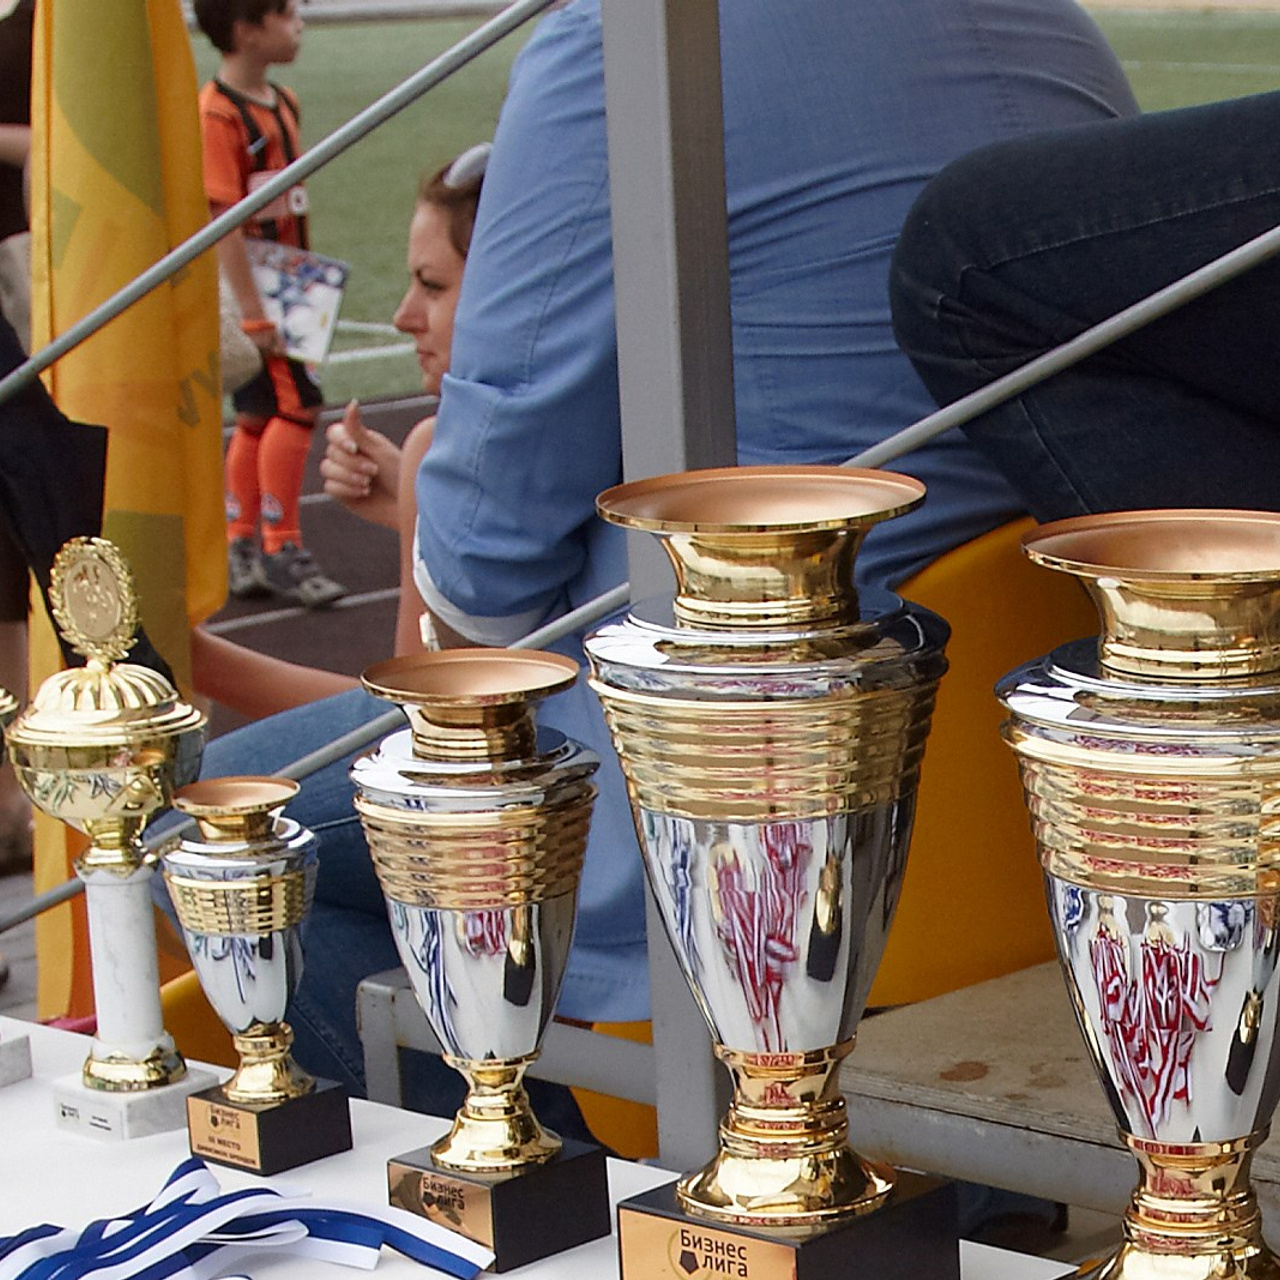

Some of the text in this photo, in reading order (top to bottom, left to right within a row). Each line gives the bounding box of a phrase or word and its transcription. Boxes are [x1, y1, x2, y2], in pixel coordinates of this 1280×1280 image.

[423, 1177, 464, 1199] Бизнес
[680, 1229, 747, 1260] Бизнес
[702, 1255, 748, 1278] лига
